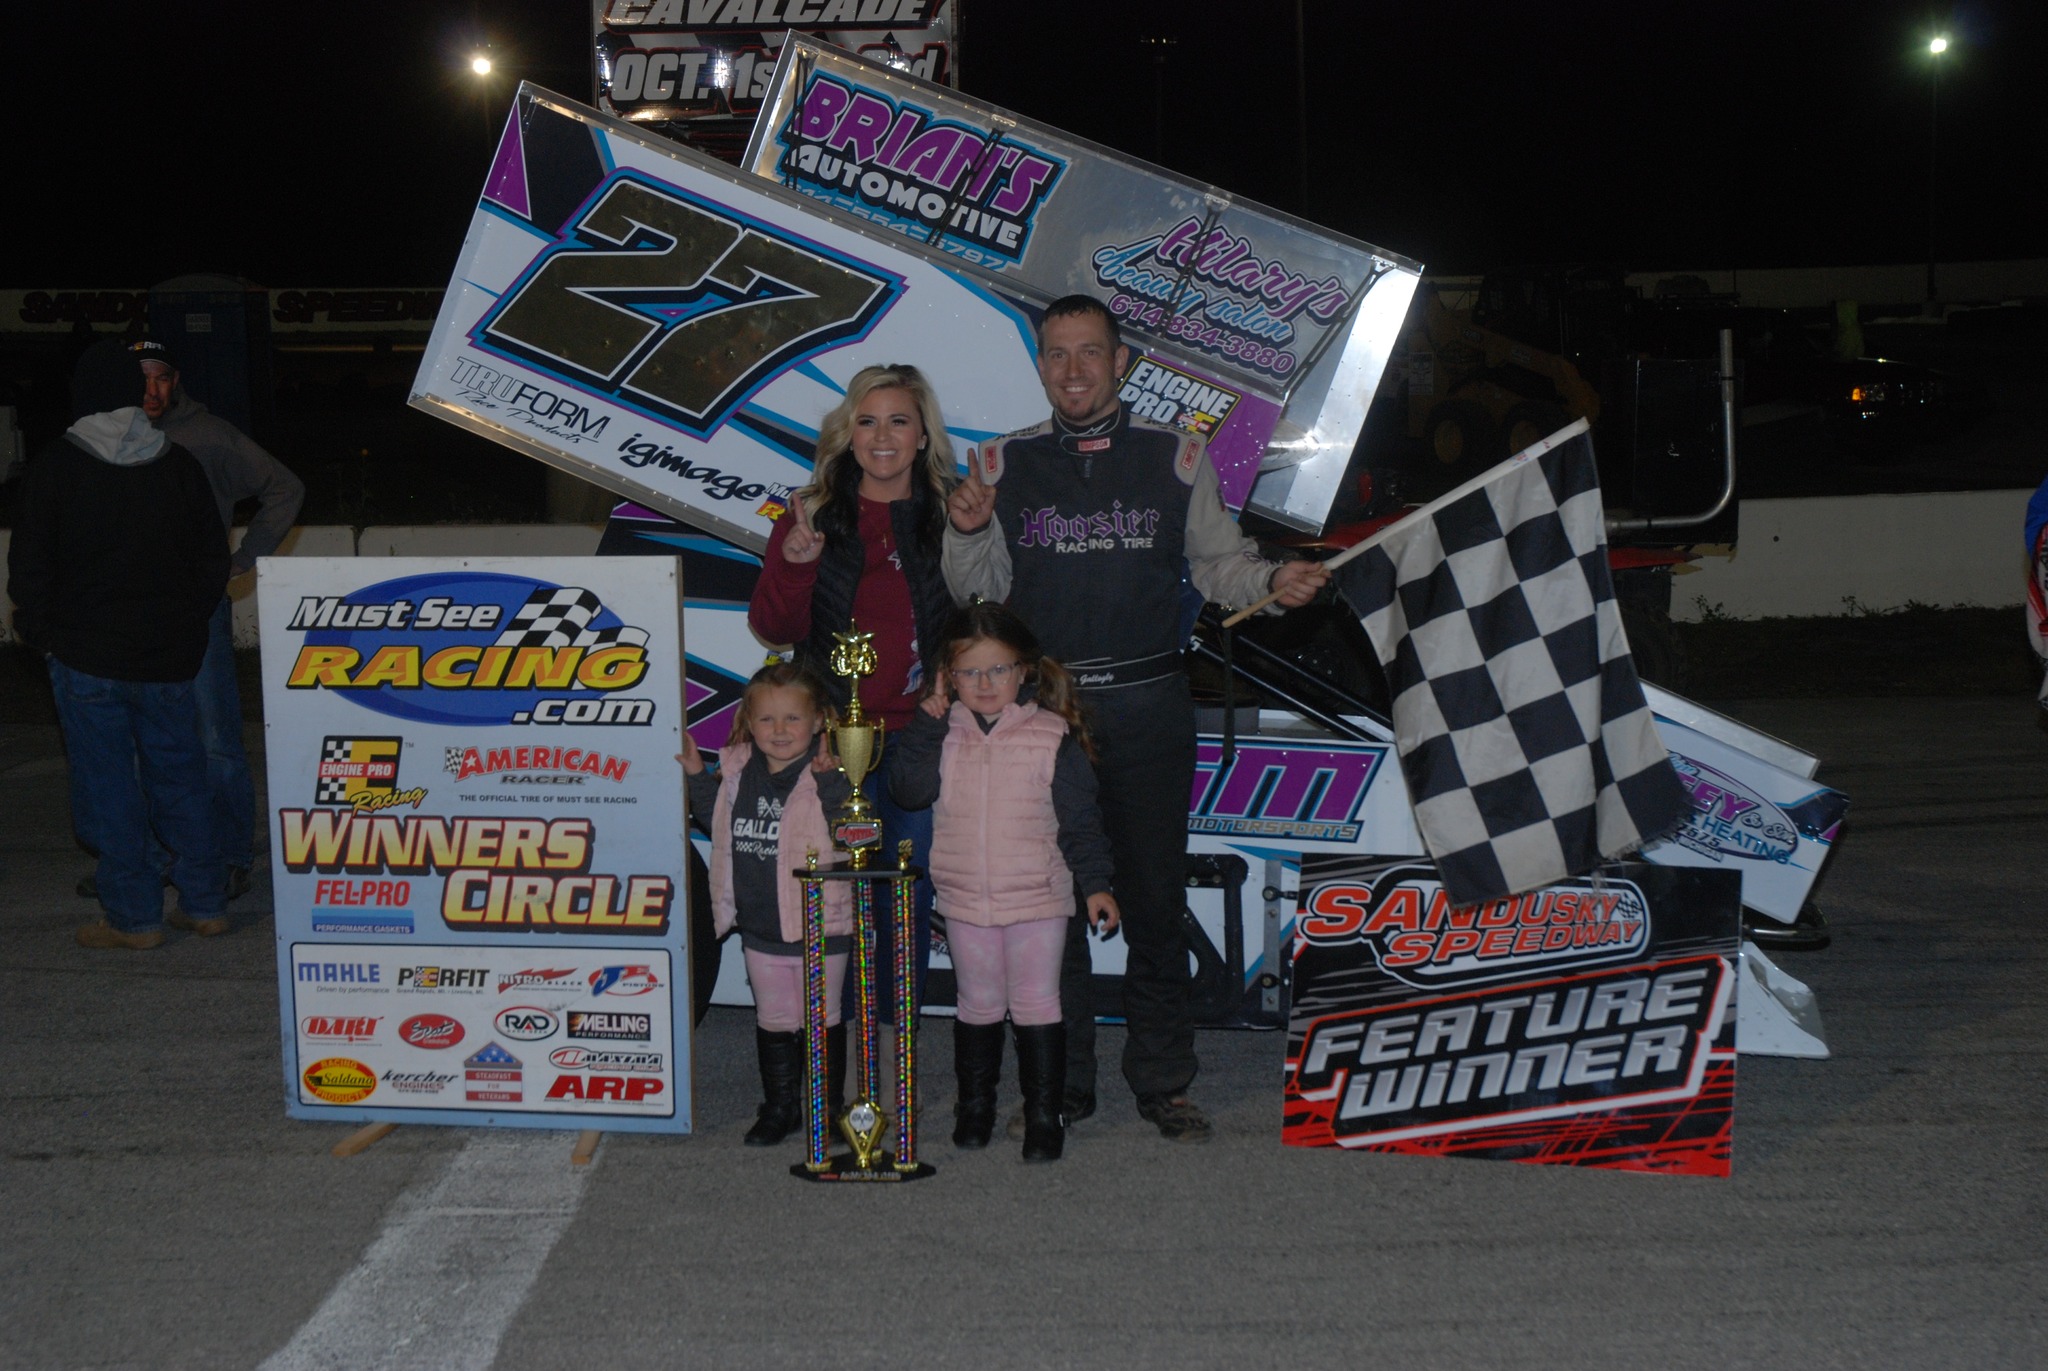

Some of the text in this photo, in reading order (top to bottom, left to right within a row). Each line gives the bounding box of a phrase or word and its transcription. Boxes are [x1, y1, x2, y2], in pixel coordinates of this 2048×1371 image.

[608, 0, 926, 25] CAVALCADE
[611, 53, 710, 100] OCT.
[788, 78, 1054, 217] BRIAN'S
[788, 145, 1024, 249] AUTOMOTIVE
[486, 166, 910, 440] 27
[1206, 298, 1293, 340] salon
[450, 356, 611, 439] TRUFORM
[1129, 361, 1237, 419] ENGINE
[1118, 386, 1179, 424] PRO
[617, 433, 766, 501] igimage
[1018, 500, 1161, 548] Hoosier
[1055, 537, 1154, 553] RACING TIRE
[287, 596, 503, 632] Must See
[286, 645, 652, 692] RACING
[511, 698, 656, 726] .com
[321, 763, 393, 777] ENGINE PRO
[455, 745, 631, 783] AMERICAN
[501, 774, 585, 785] RACER
[350, 787, 429, 817] Racing
[479, 795, 518, 803] OFFICIAL
[542, 796, 555, 804] OF
[557, 796, 582, 804] MUST
[603, 797, 638, 805] RACING
[280, 808, 595, 875] WINNERS
[733, 817, 780, 841] GALLO
[1702, 815, 1790, 865] HEATING
[314, 880, 411, 907] FEL-PRO
[442, 869, 674, 936] CIRCLE
[316, 924, 411, 934] PERFORMANCE GASKETS
[1382, 920, 1641, 965] SPEEDWAY
[298, 963, 380, 983] MAHLE
[498, 974, 545, 986] NITRO
[306, 1016, 384, 1036] DART
[505, 1014, 550, 1031] RAD
[577, 1014, 649, 1033] MELLING
[1303, 968, 1709, 1075] FEATURE
[320, 1058, 358, 1069] RACING
[380, 1069, 459, 1083] kercher
[475, 1072, 512, 1080] STEADFAST
[323, 1072, 374, 1085] Saldana
[545, 1075, 664, 1101] ARP
[477, 1092, 511, 1100] VETERANS
